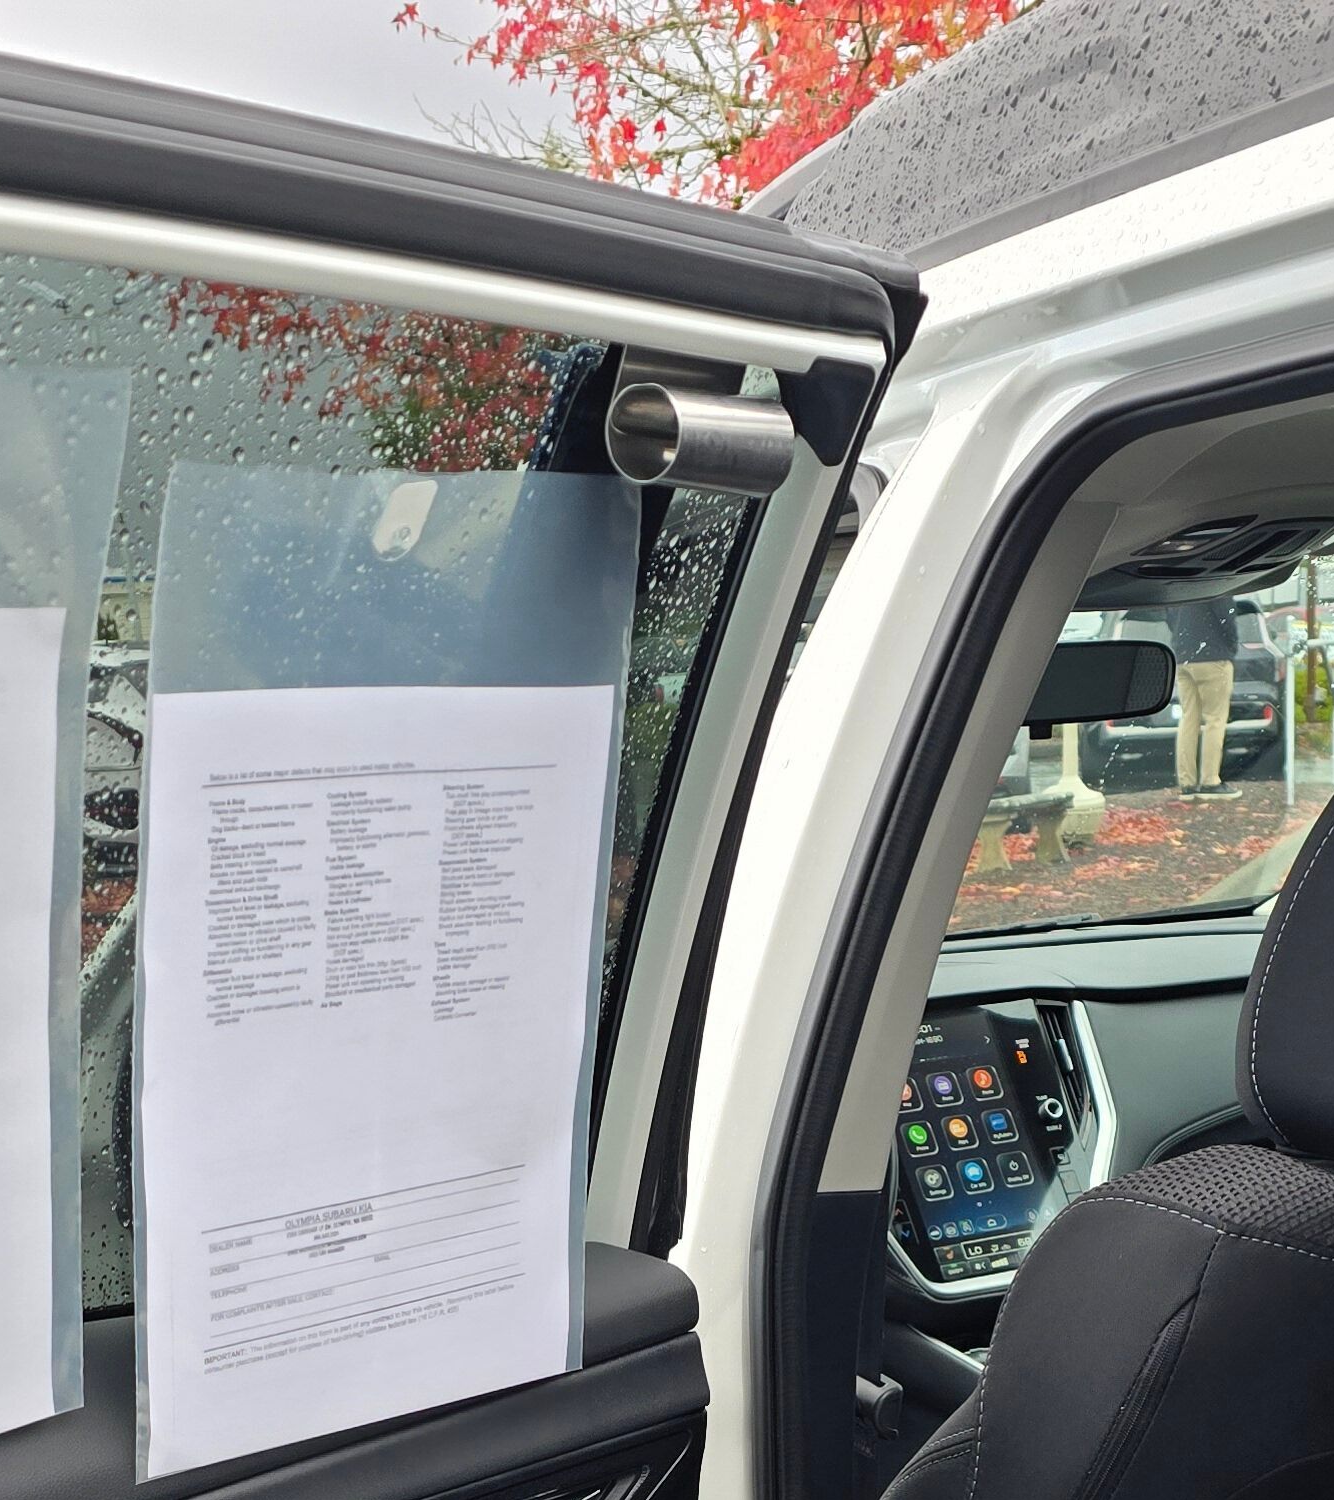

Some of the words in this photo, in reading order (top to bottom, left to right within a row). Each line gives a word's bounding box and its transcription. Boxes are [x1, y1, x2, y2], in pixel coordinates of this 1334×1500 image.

[285, 1214, 320, 1228] OLYMPIA
[323, 1206, 357, 1221] SUBARU
[359, 1203, 372, 1213] KIA
[968, 1246, 983, 1256] LO
